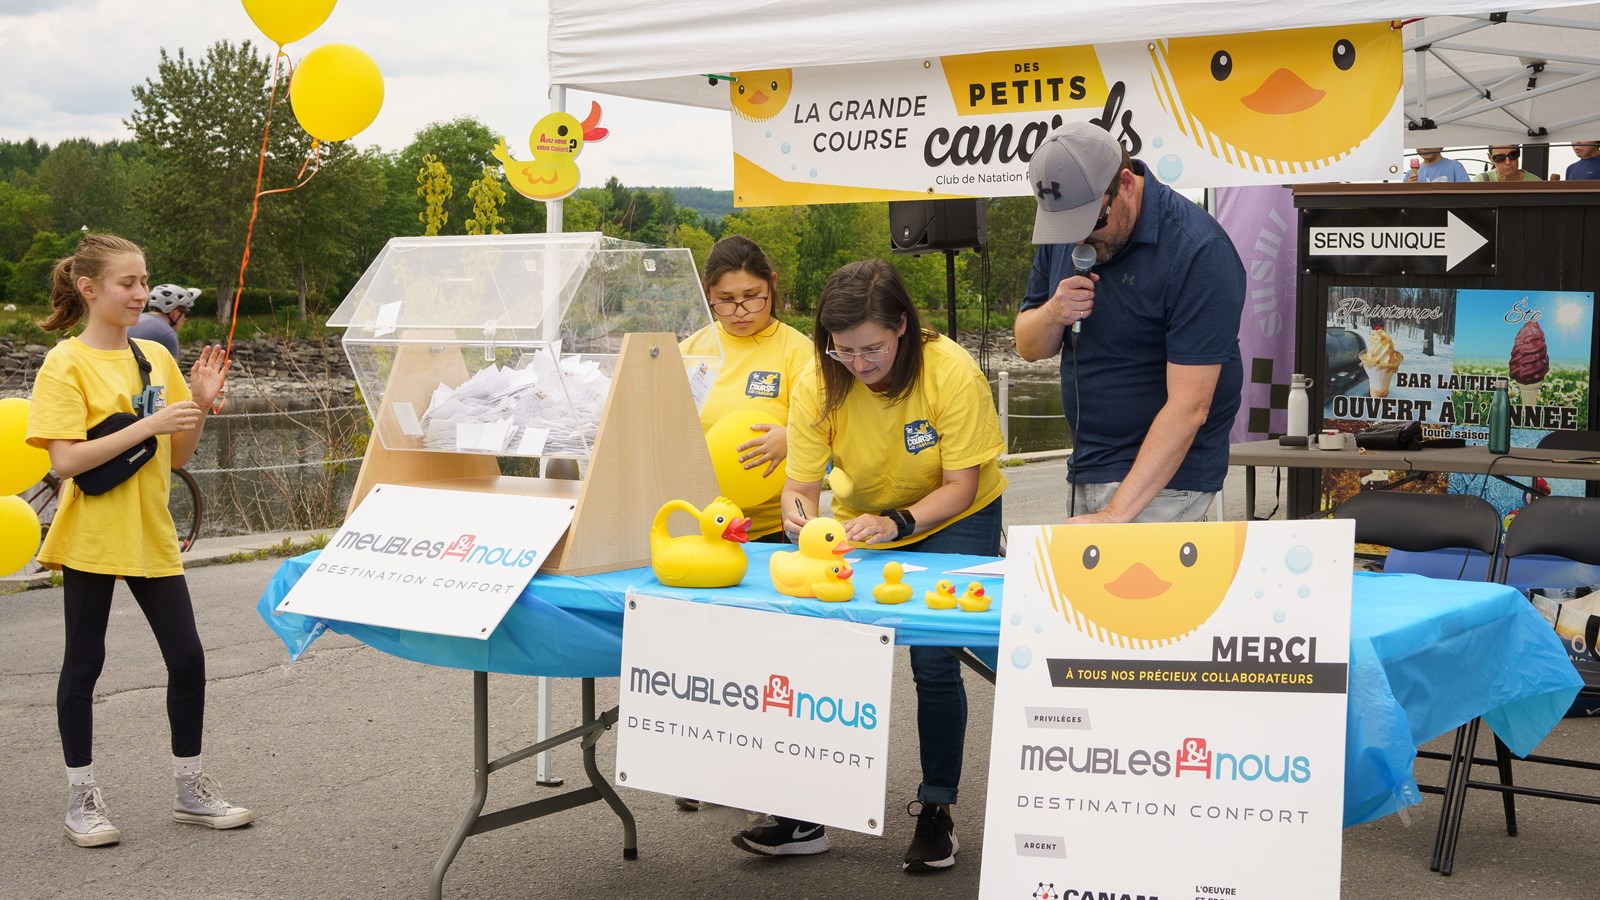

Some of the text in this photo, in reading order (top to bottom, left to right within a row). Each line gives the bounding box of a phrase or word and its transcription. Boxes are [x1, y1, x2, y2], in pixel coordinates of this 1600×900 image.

[1014, 62, 1040, 73] DES
[969, 75, 1087, 107] PETITS
[794, 95, 928, 124] LA GRANDE
[924, 80, 1142, 167] canads
[812, 127, 908, 154] COURSE
[935, 174, 960, 185] Club
[961, 174, 975, 184] de
[978, 172, 1023, 184] Natation
[1313, 232, 1446, 250] SENS UNIQUE
[1251, 207, 1289, 338] SUSHI
[1336, 297, 1443, 324] Printemps
[1504, 296, 1544, 324] Été
[1396, 372, 1508, 392] BAR LAITIE
[1332, 395, 1432, 423] OUVERT
[1439, 395, 1457, 424] À
[907, 434, 934, 446] COURSE
[1423, 427, 1451, 438] toute
[316, 562, 515, 595] DESTINATION CONFORT
[1211, 635, 1317, 663] MERCI
[1065, 667, 1314, 685] À TOUS NOS PRÉCIEUX COLLABORATEURS
[1033, 714, 1083, 724] PRIVILÈGES
[627, 716, 875, 769] DESTINATION CONFORT
[1017, 795, 1310, 824] DESTINATION CONFORT
[1023, 842, 1058, 851] ARGENT
[1195, 885, 1237, 896] L'OEUVRE
